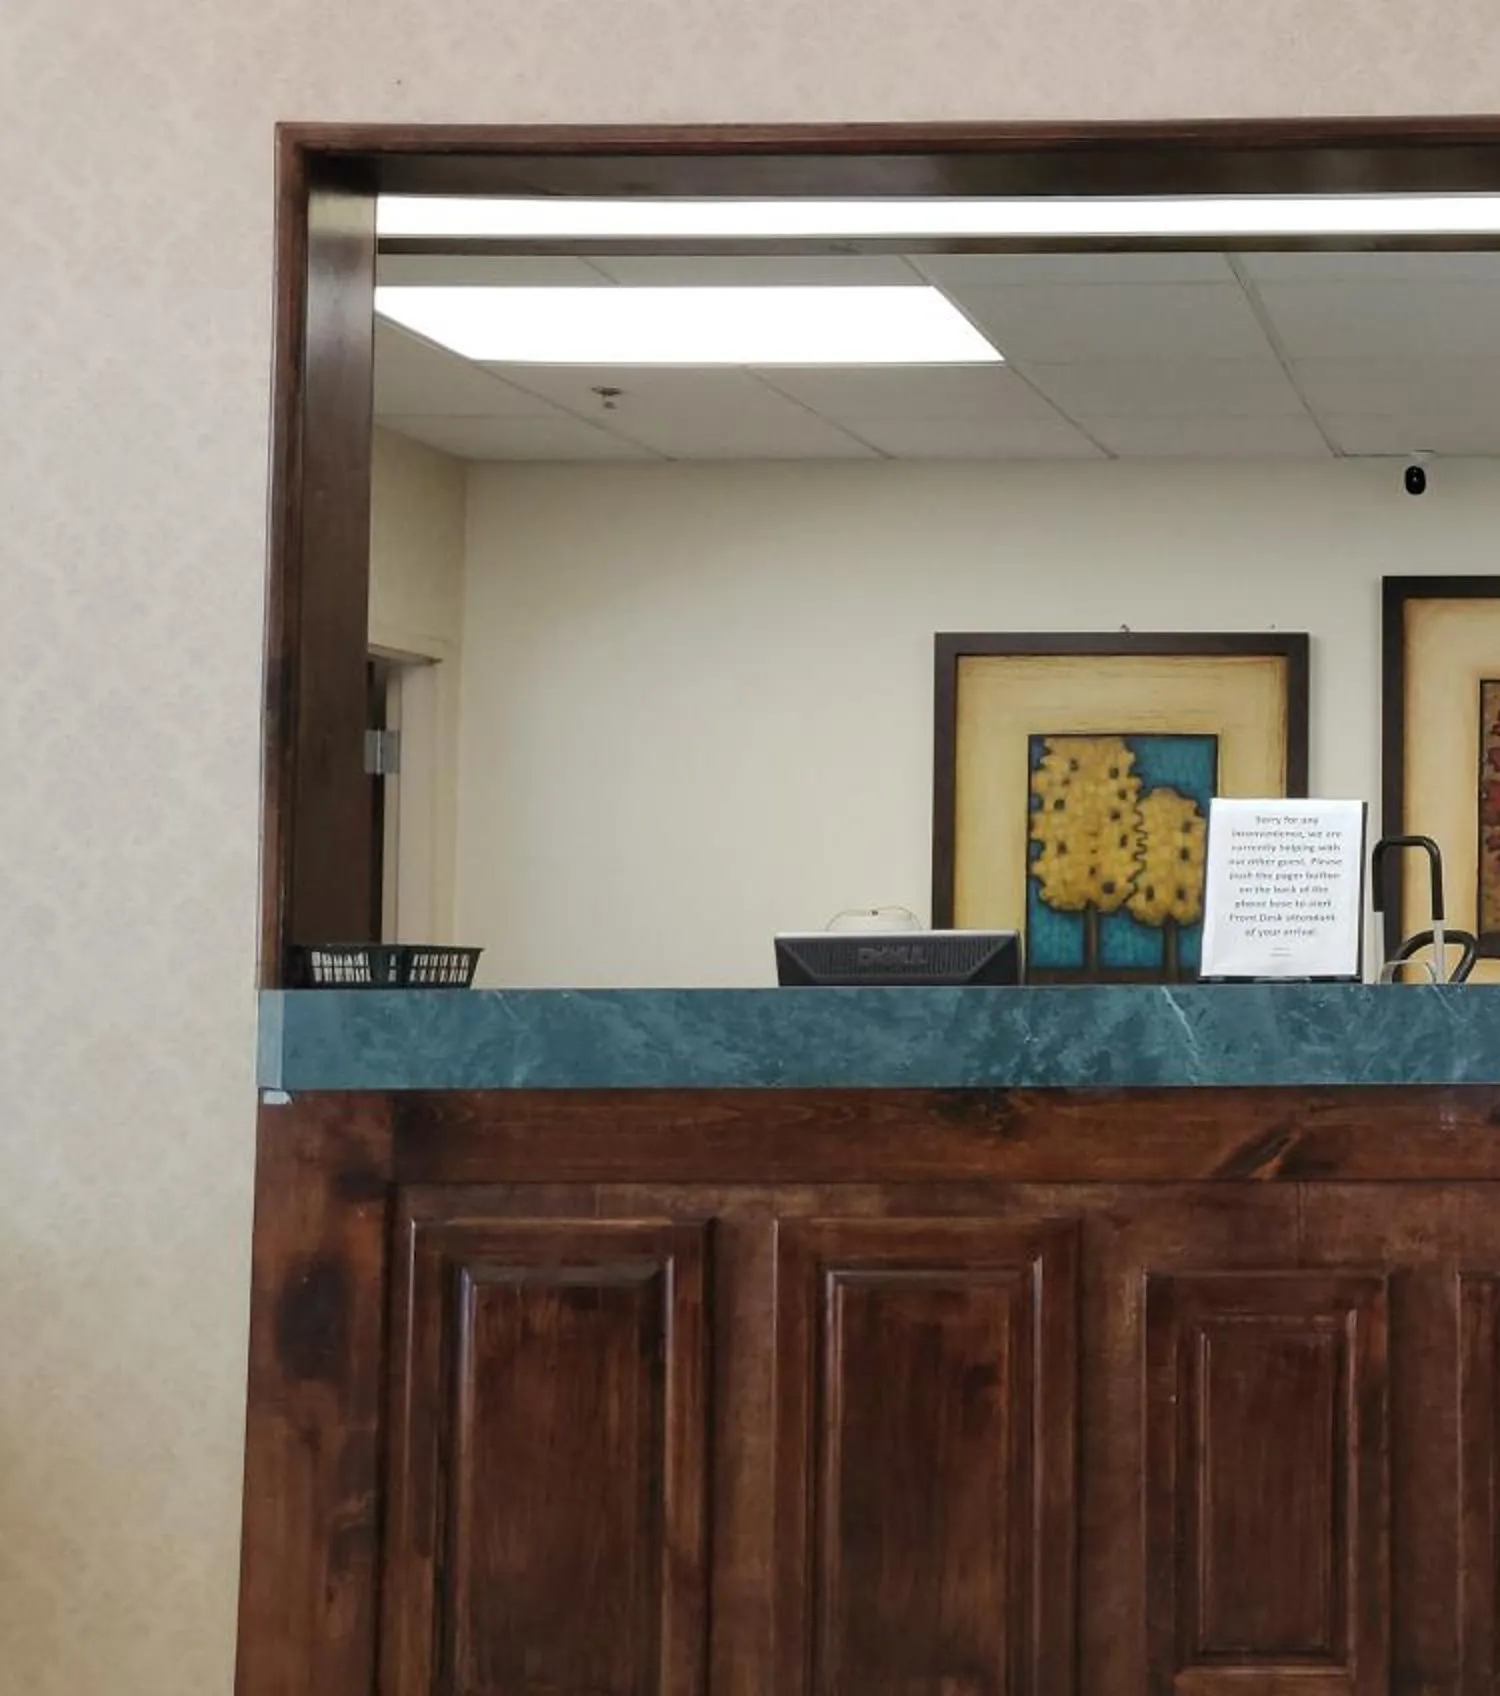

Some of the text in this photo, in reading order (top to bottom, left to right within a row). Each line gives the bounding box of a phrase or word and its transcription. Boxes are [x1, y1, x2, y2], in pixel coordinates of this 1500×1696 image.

[1256, 815, 1318, 826] Sorry for any
[1231, 843, 1341, 853] currently helping with
[1247, 858, 1275, 866] other
[1311, 857, 1342, 865] Please
[1229, 871, 1252, 880] push
[1305, 871, 1341, 879] button
[1255, 885, 1271, 893] the
[1273, 885, 1296, 893] back
[1299, 885, 1309, 893] of
[1229, 913, 1335, 922] Front Desk attendant
[1245, 927, 1257, 936] of
[1257, 928, 1281, 937] your
[858, 944, 928, 965] DELL
